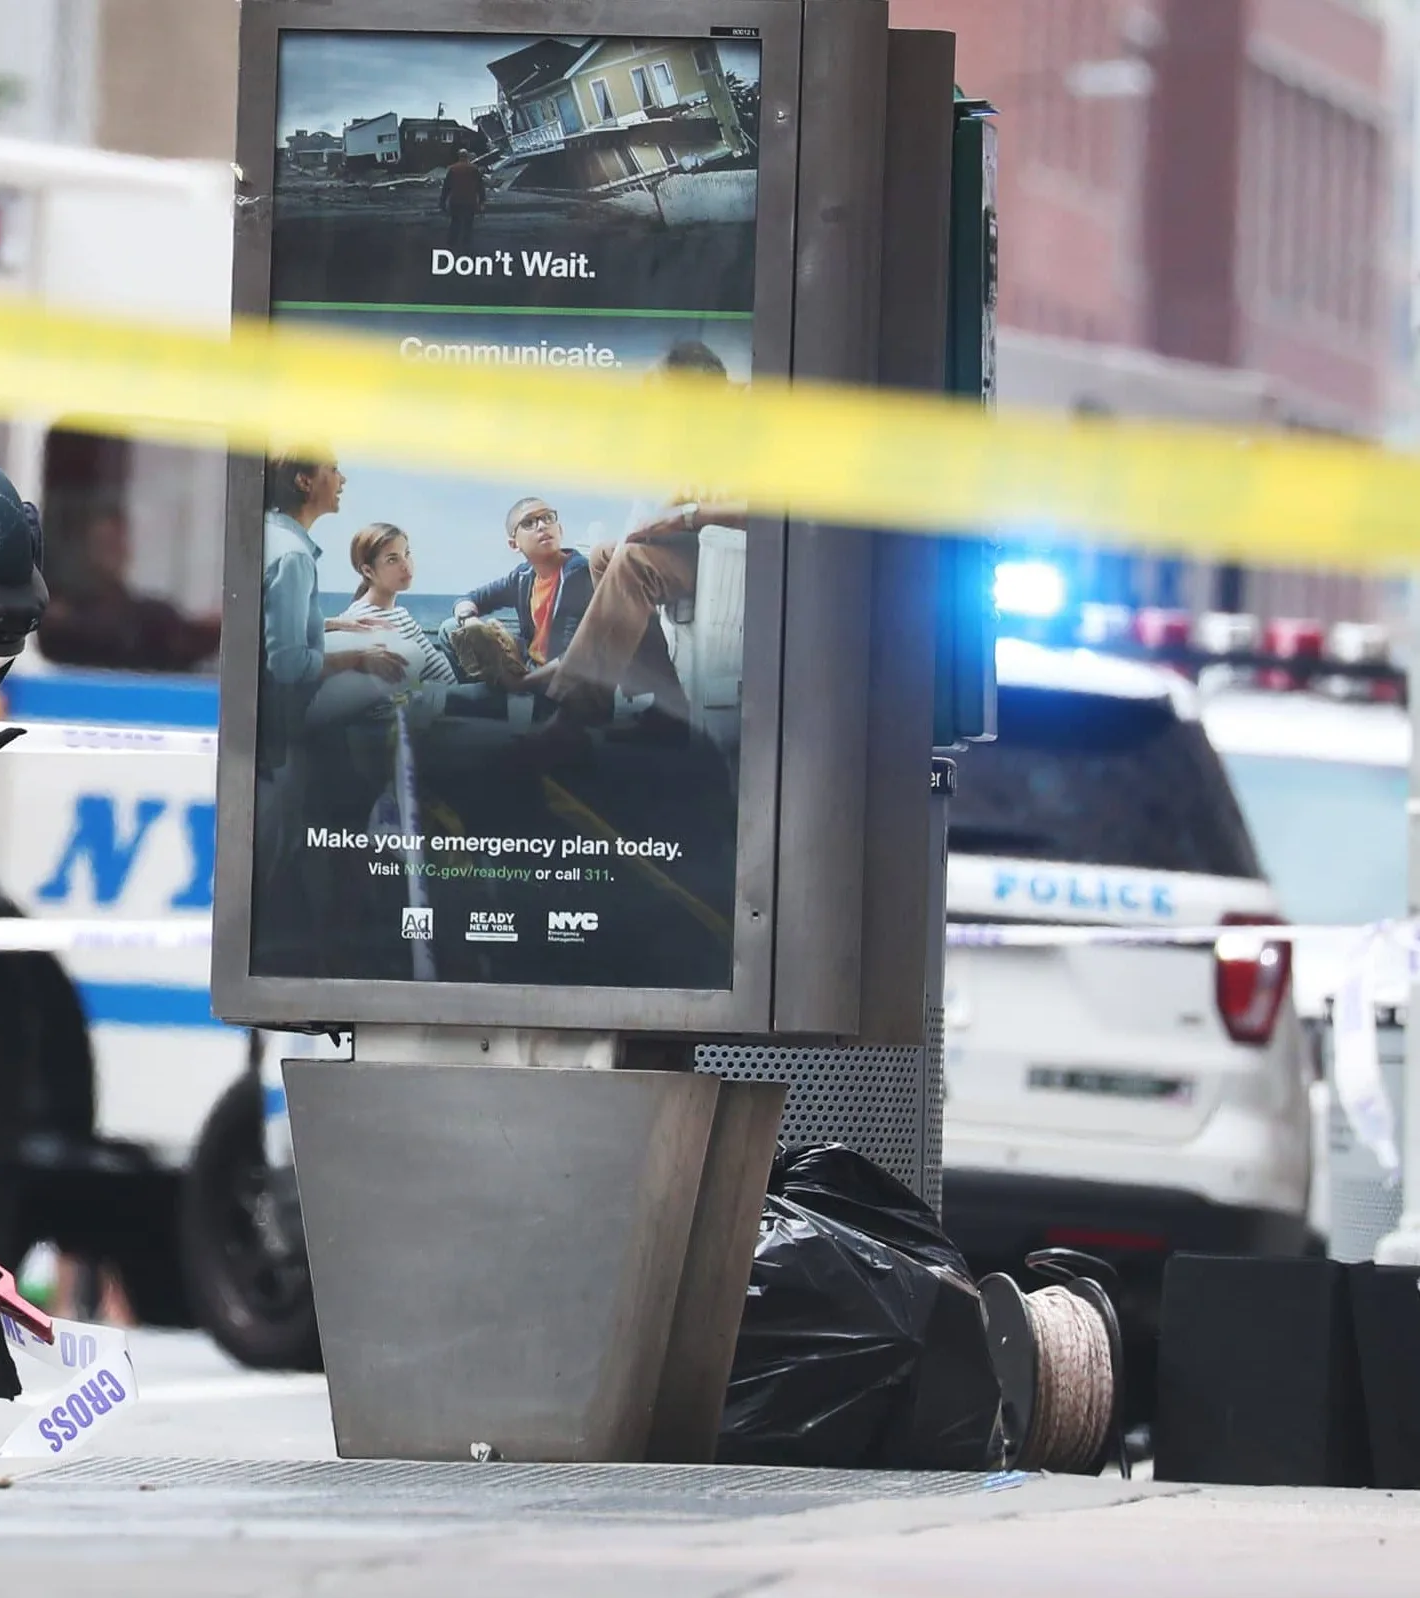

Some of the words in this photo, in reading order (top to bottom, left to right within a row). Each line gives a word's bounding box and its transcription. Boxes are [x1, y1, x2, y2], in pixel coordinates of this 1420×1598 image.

[432, 249, 513, 276] Don’t
[521, 251, 596, 278] Wait.
[399, 336, 623, 369] Communicate.
[307, 827, 369, 848] Make
[374, 833, 425, 853] your
[431, 835, 556, 858] emergency
[561, 835, 609, 858] plan
[615, 837, 683, 861] today.
[368, 862, 400, 876] Visit
[404, 863, 531, 881] NYC.gov/readyny
[535, 869, 551, 880] or
[555, 867, 580, 881] call
[584, 868, 614, 882] 311.
[404, 913, 431, 931] Ad
[470, 911, 515, 924] READY
[548, 911, 599, 930] NYC
[469, 923, 488, 932] NEW
[491, 924, 515, 933] YORK
[38, 1368, 126, 1452] CROSS
